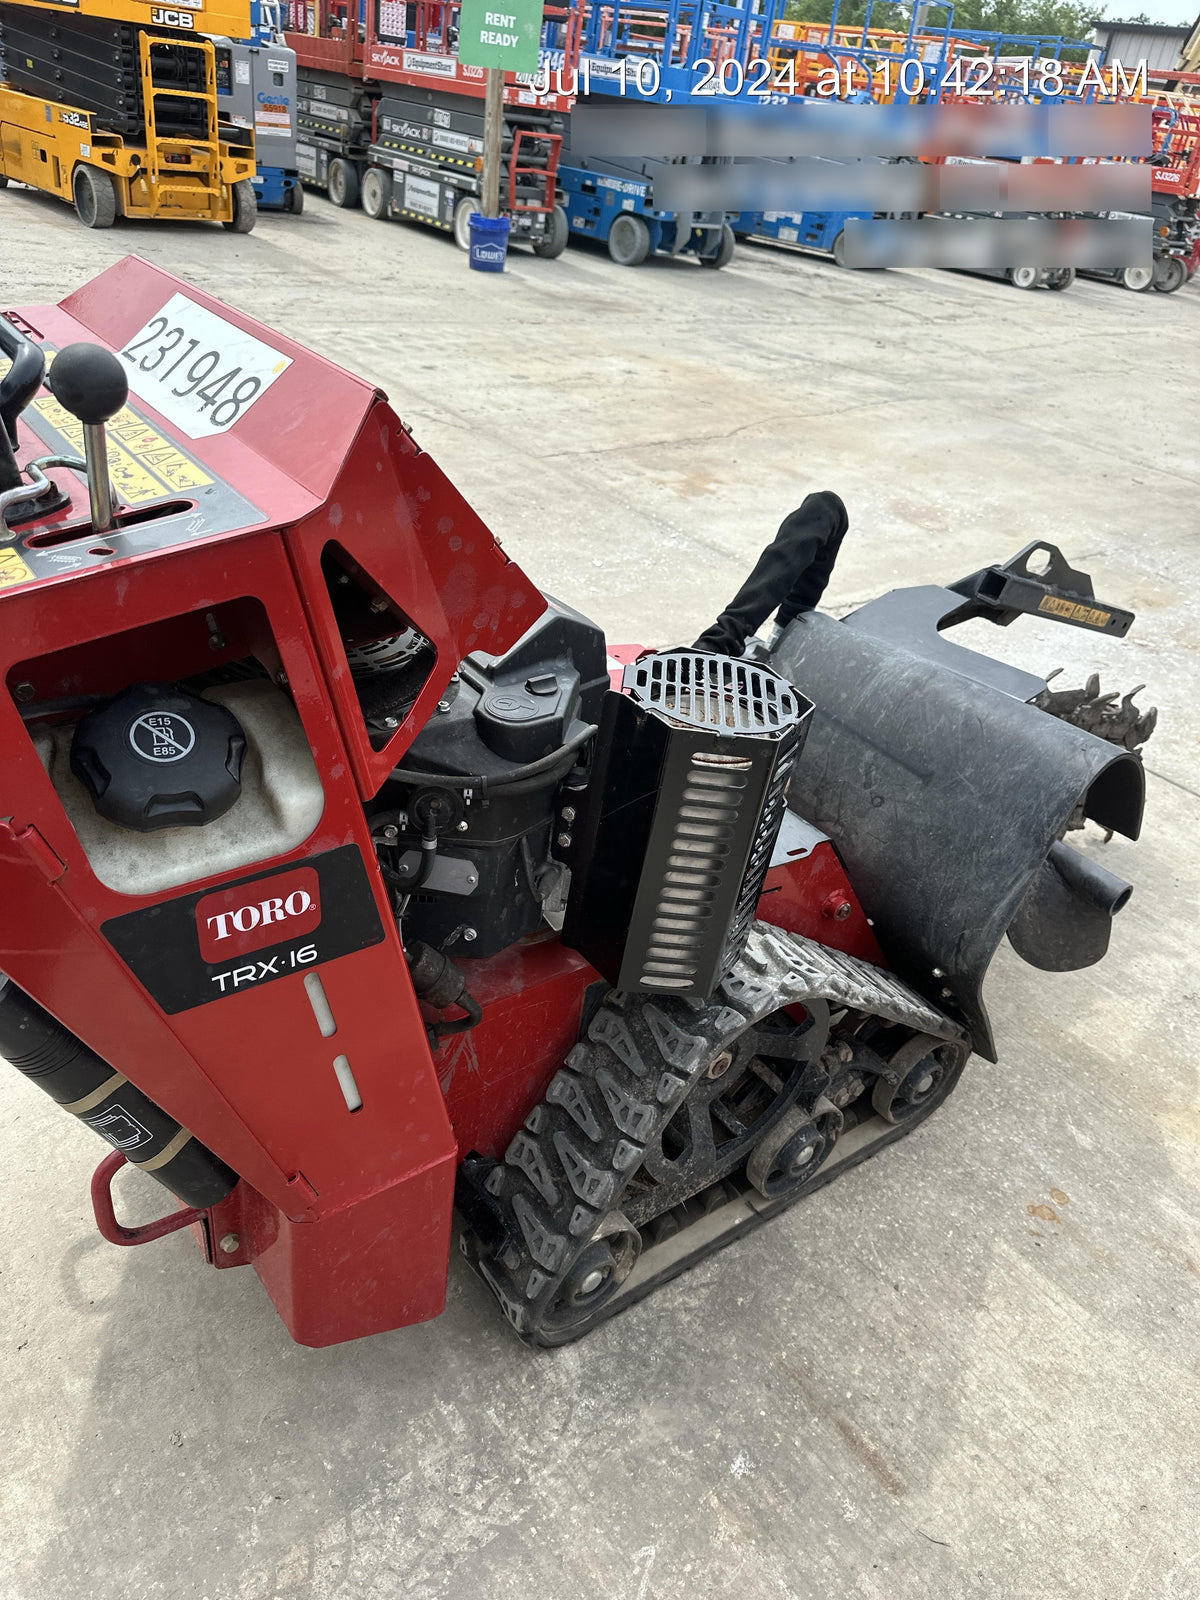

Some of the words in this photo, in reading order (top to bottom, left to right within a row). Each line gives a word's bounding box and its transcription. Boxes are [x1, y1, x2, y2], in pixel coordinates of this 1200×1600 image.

[152, 9, 193, 28] JCB
[485, 12, 516, 28] RENT
[480, 31, 519, 47] READY
[371, 50, 400, 66] SKYJACK
[257, 92, 290, 105] Genie
[392, 122, 420, 139] SKYJACK
[121, 317, 261, 427] 231948
[148, 717, 171, 726] E15
[153, 746, 176, 756] E85
